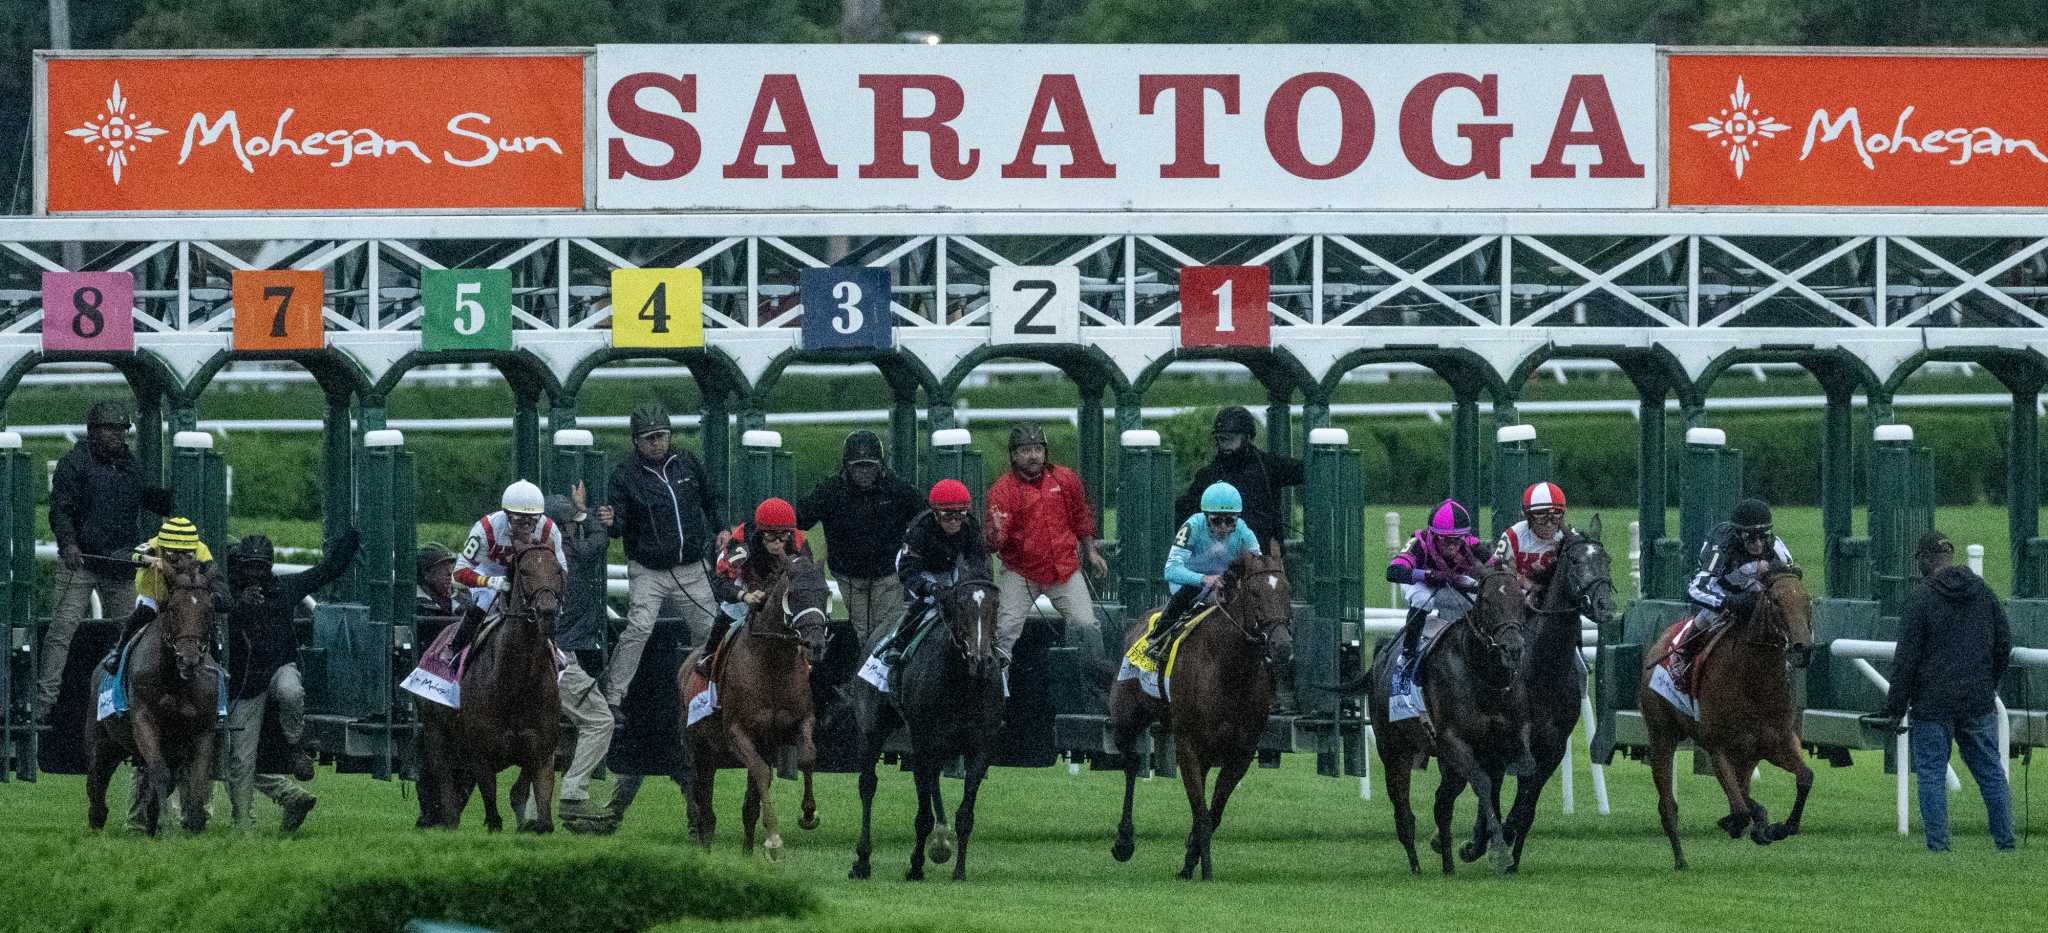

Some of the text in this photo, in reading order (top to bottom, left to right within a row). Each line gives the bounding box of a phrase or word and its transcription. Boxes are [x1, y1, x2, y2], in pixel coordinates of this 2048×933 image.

[177, 107, 563, 174] Mohegan Sun
[608, 74, 1644, 180] SARATOGA
[1799, 105, 2048, 171] Mohegan
[71, 286, 105, 339] 8
[263, 286, 295, 338] 7
[453, 282, 486, 335] 5
[638, 283, 671, 333] 4
[832, 281, 864, 334] 3
[1013, 280, 1057, 335] 2
[1212, 279, 1236, 333] 1
[463, 537, 480, 560] 8
[1175, 526, 1189, 547] 4
